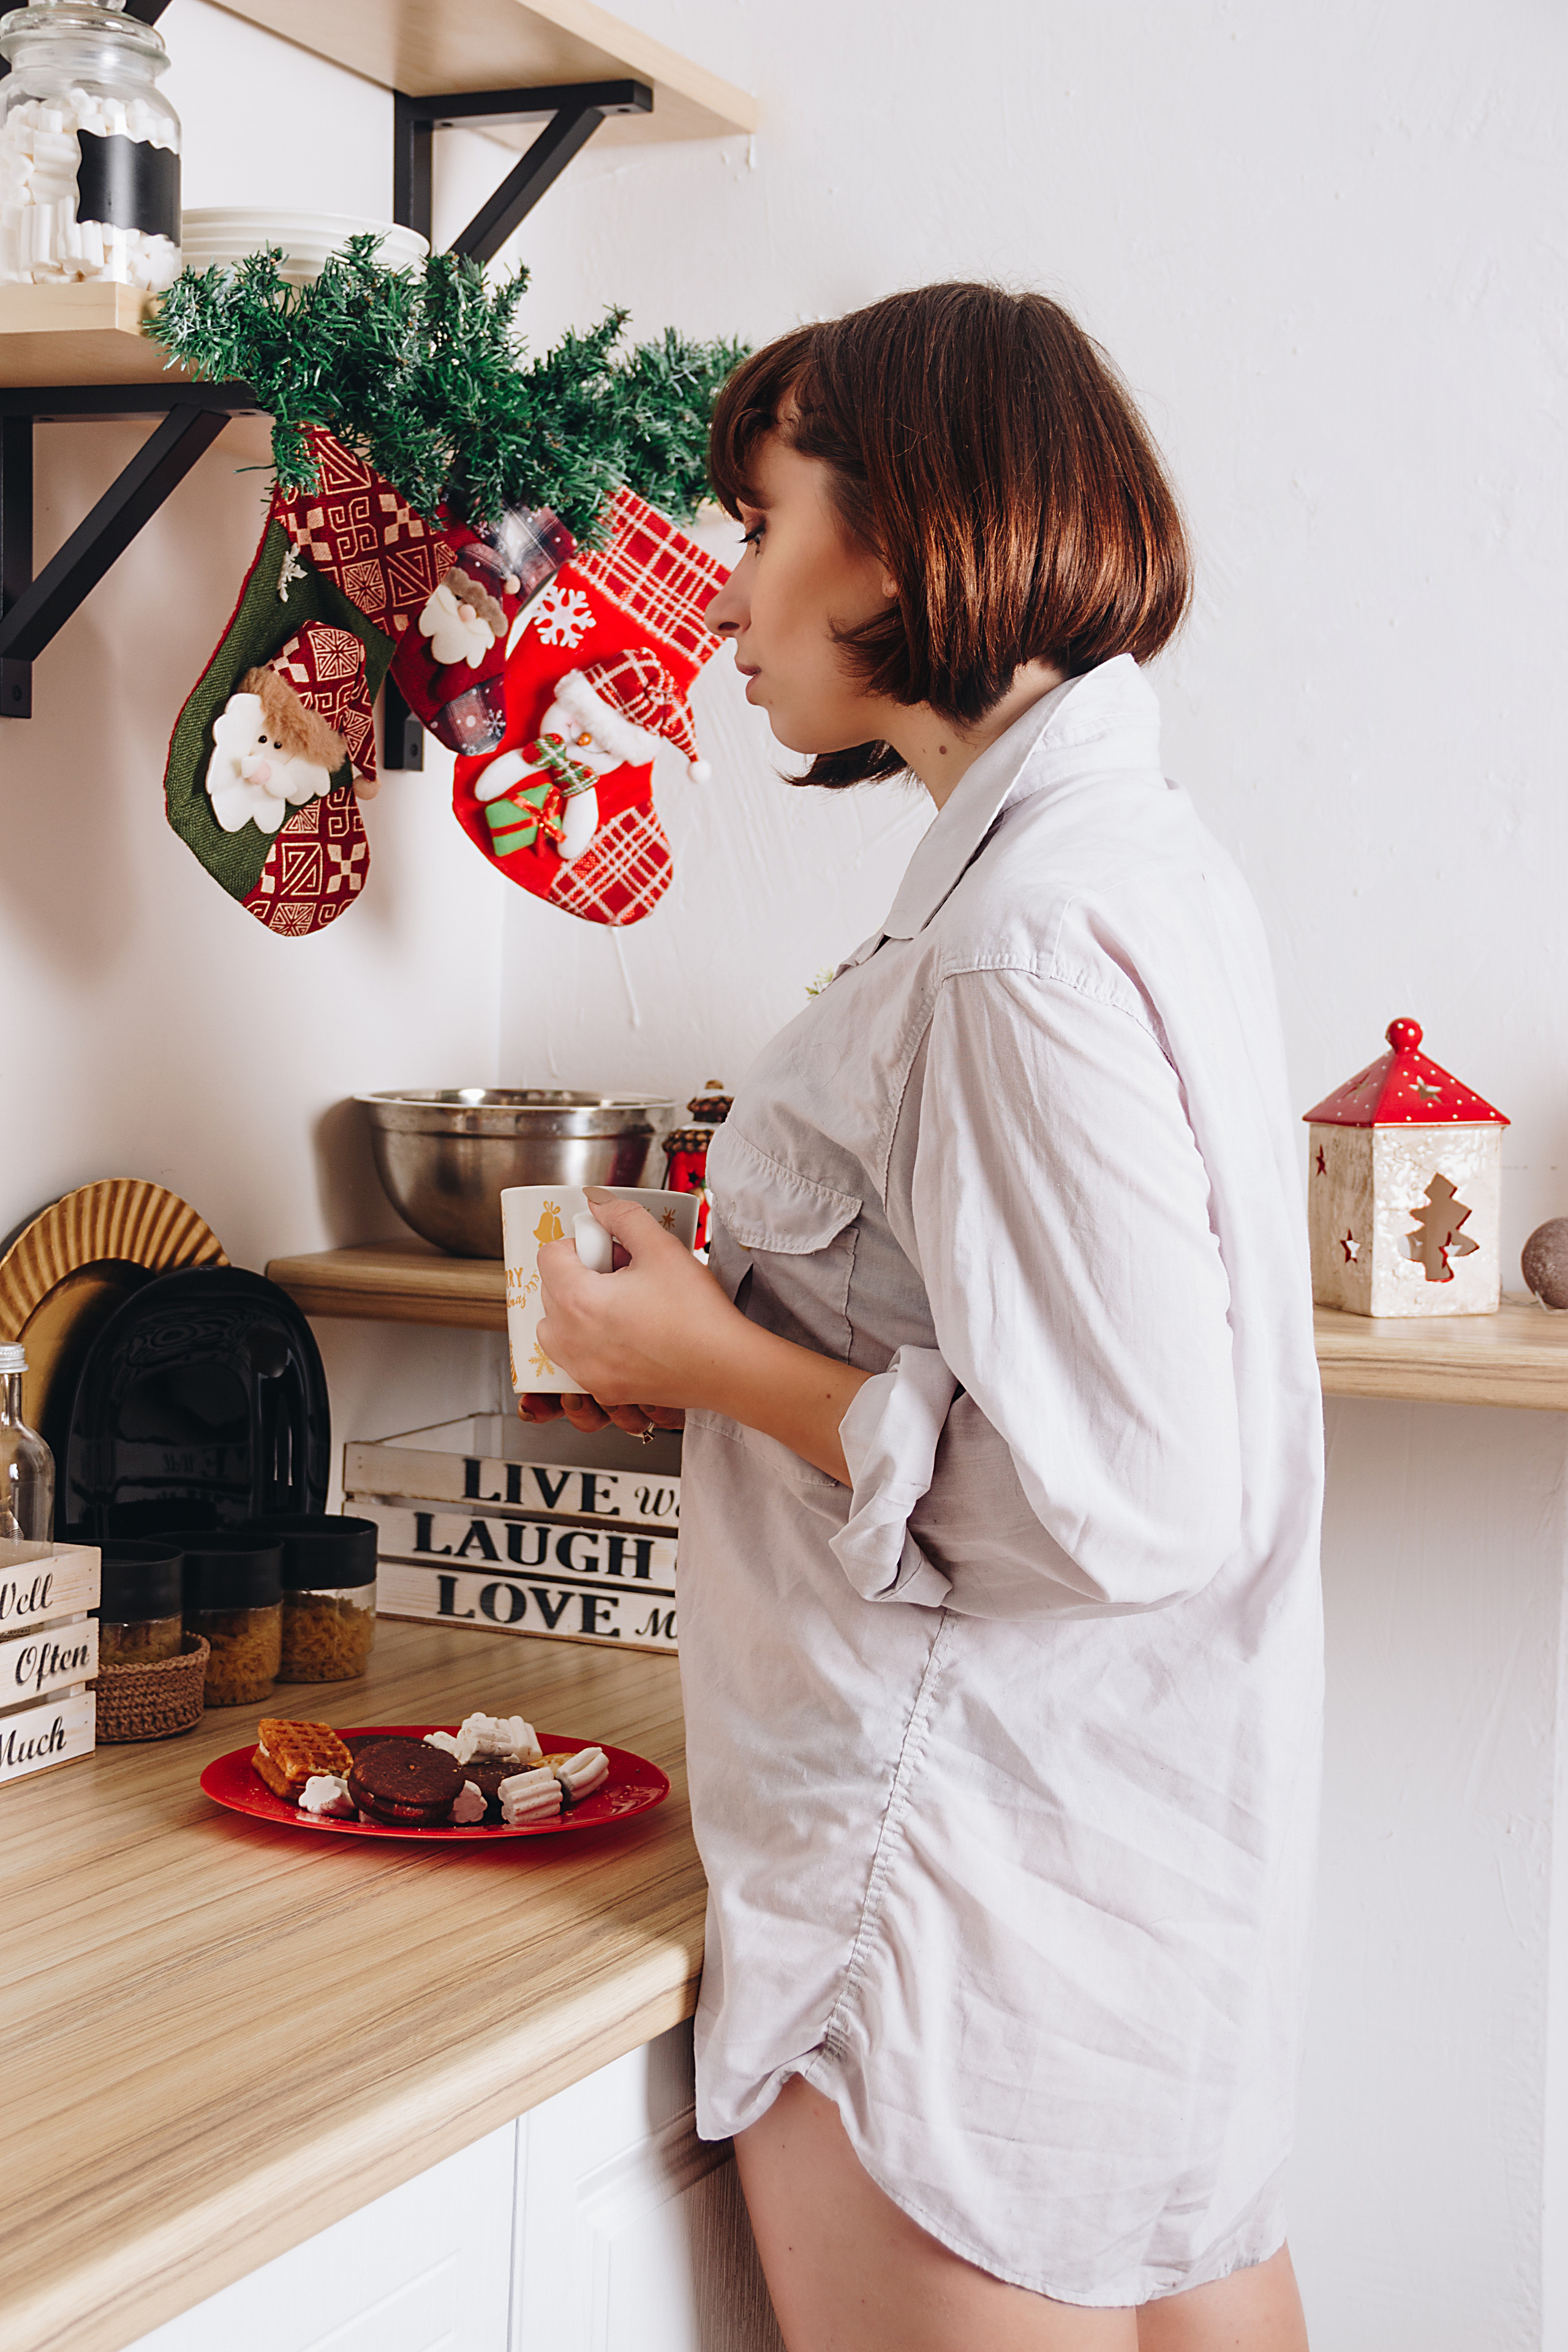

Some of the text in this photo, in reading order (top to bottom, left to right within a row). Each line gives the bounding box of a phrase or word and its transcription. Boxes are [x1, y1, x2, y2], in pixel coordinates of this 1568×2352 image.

[462, 1458, 620, 1516] LIVE
[413, 1512, 655, 1580] LAUGH
[437, 1574, 620, 1638] LOVE
[15, 1643, 90, 1692] Often
